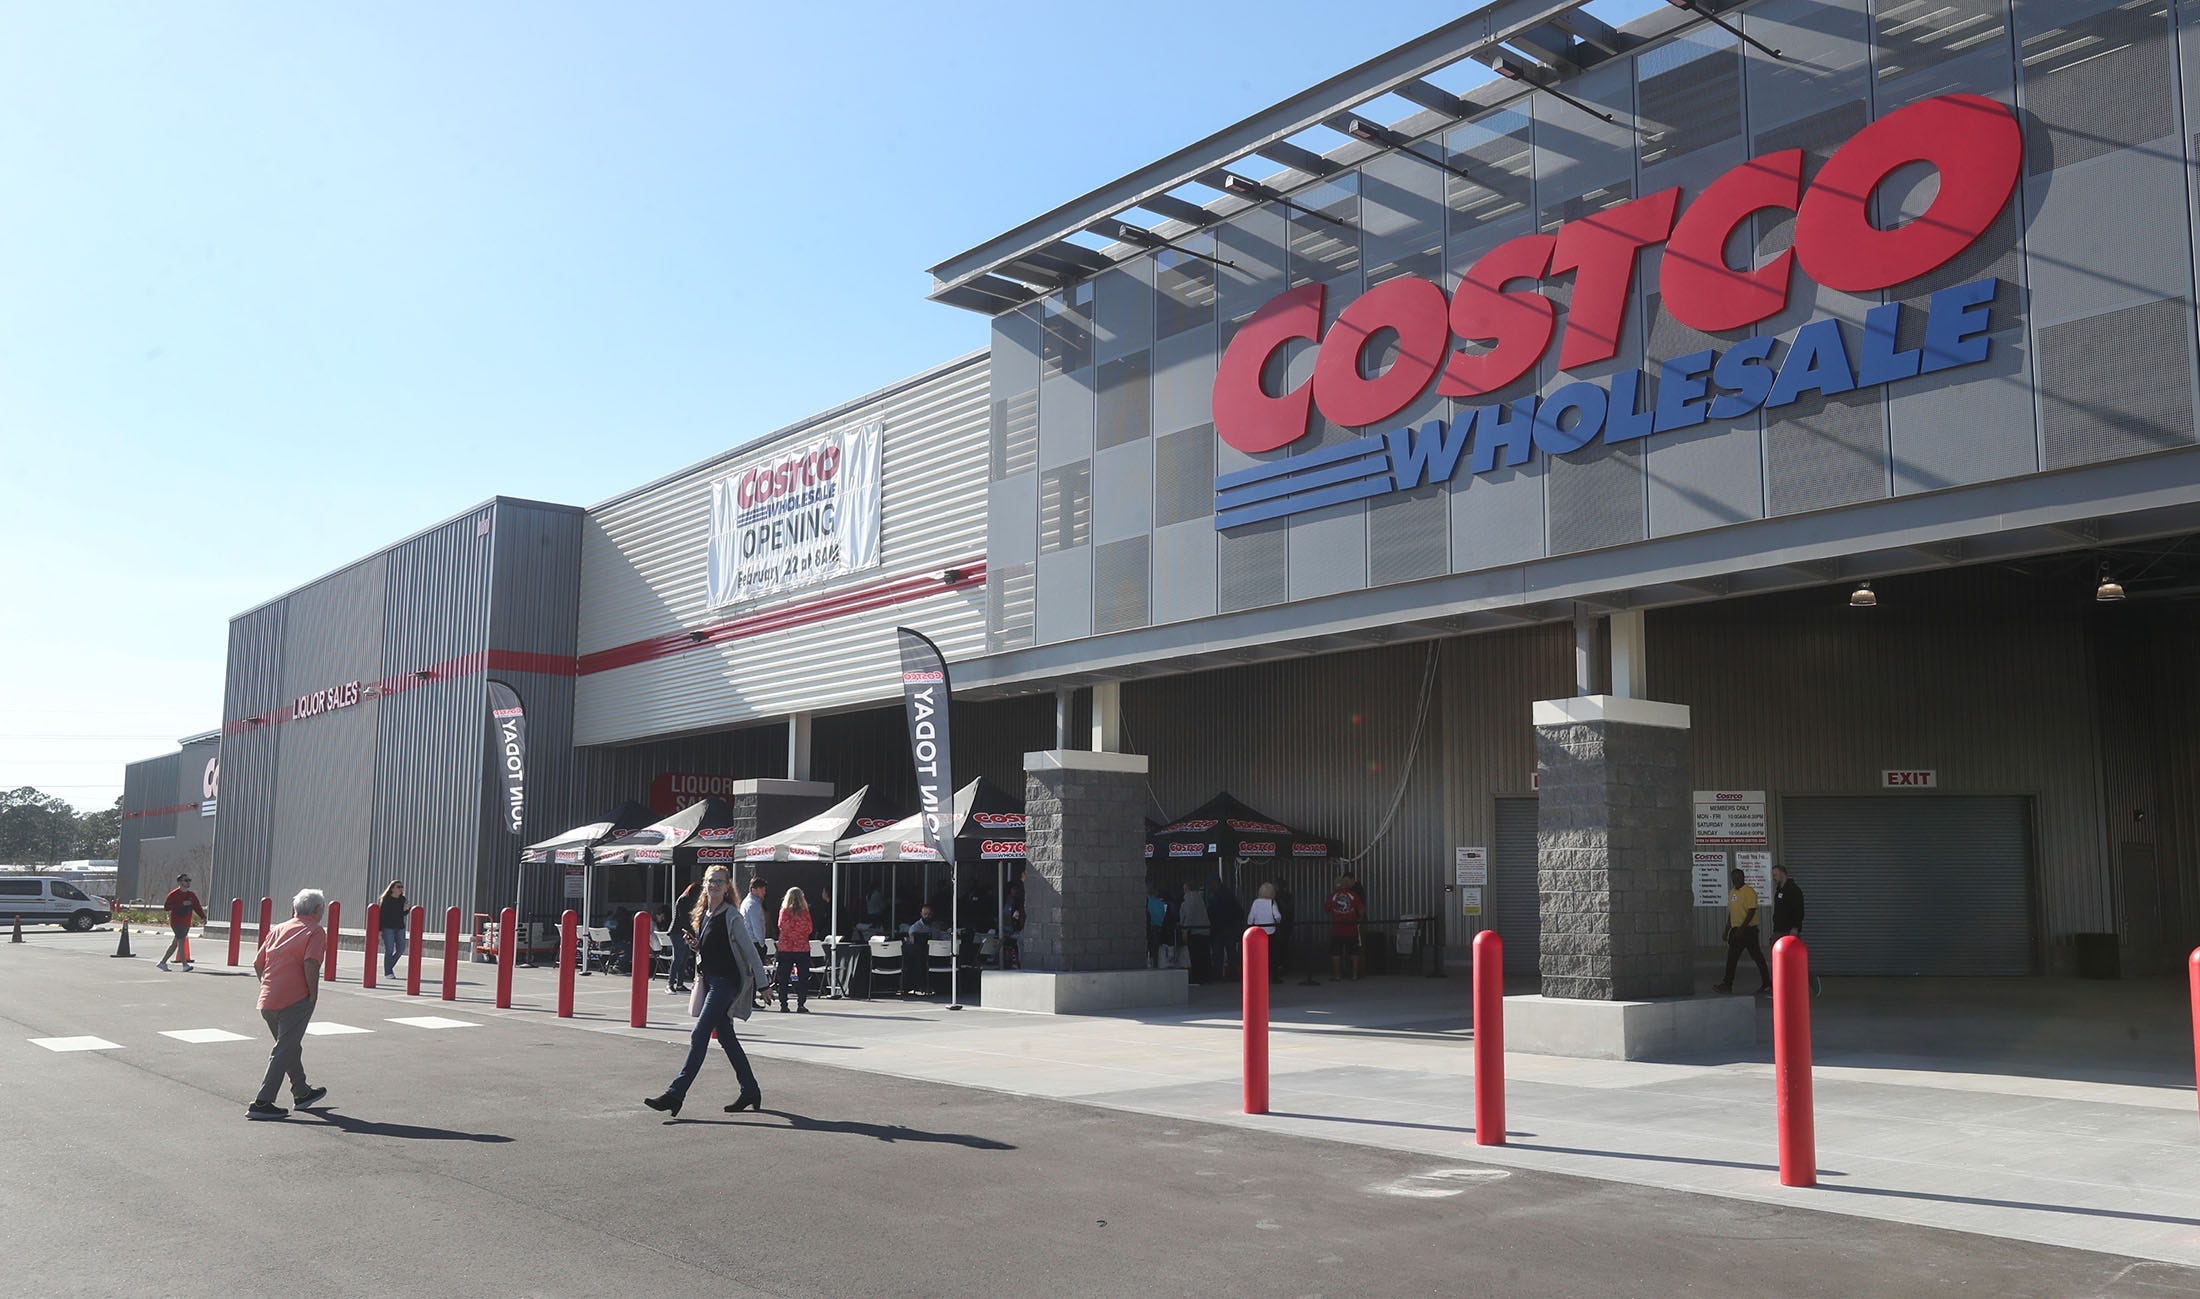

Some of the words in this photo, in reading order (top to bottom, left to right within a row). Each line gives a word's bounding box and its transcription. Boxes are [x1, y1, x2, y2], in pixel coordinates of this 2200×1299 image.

[1212, 93, 2023, 453] COSTCO
[1391, 277, 1997, 490] WHOLESALE
[737, 446, 841, 509] COSTCO
[767, 483, 836, 519] WHOLESALE
[743, 503, 836, 559] OPENING
[737, 566, 779, 589] February
[784, 556, 798, 576] 22
[801, 553, 812, 570] at
[292, 690, 326, 720] LIQUOR
[327, 680, 360, 711] SALES
[671, 776, 732, 794] LIQUOR
[1888, 772, 1930, 785] EXIT
[1170, 842, 1204, 852] COSTCO
[1239, 841, 1276, 852] COSTCO
